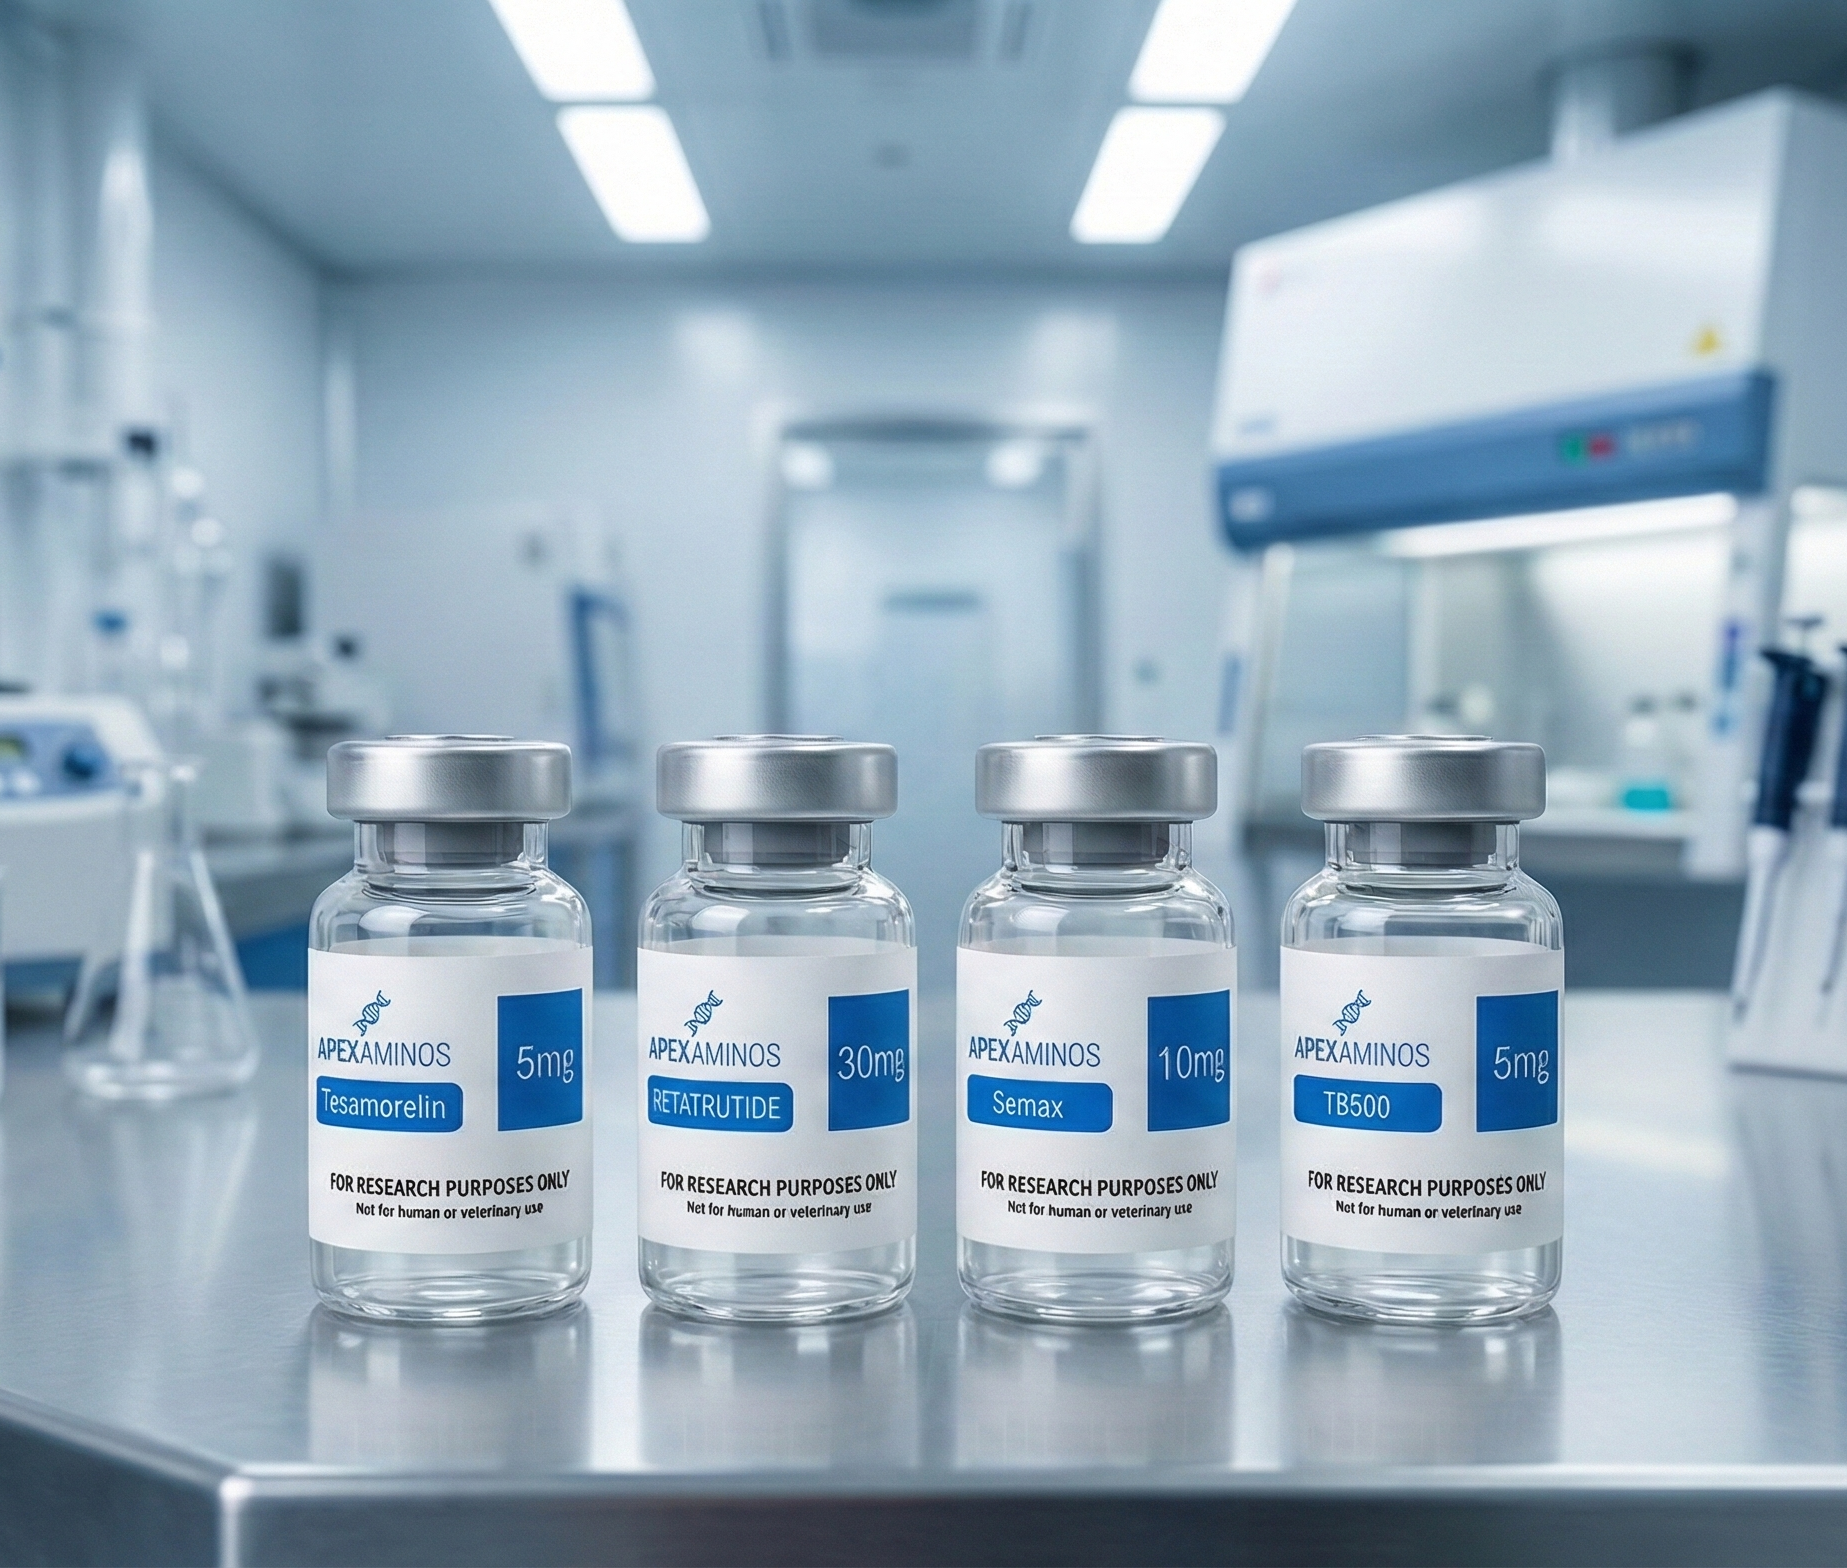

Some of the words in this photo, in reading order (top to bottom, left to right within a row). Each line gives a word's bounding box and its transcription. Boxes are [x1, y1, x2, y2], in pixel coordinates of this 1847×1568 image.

[318, 1037, 450, 1067] APEXAMINOS
[517, 1045, 574, 1083] 5mg
[649, 1036, 780, 1067] APEXAMINOS
[838, 1045, 905, 1082] 30mg
[968, 1036, 1100, 1067] APEXAMINOS
[1159, 1045, 1225, 1083] 10mg
[1295, 1036, 1429, 1067] APEXAMINOS
[1494, 1046, 1549, 1084] 5mg
[321, 1087, 445, 1119] Tesamorelin
[654, 1088, 780, 1119] RETATRUTIDE
[993, 1090, 1063, 1118] Semax
[1324, 1091, 1390, 1118] TB500
[330, 1172, 353, 1192] FOR
[357, 1177, 440, 1197] RESEARCH
[446, 1175, 533, 1197] PURPOSES
[538, 1170, 570, 1190] ONLY
[661, 1171, 683, 1191] FOR
[688, 1176, 770, 1196] RESEARCH
[776, 1175, 862, 1197] PURPOSES
[866, 1170, 897, 1190] ONLY
[981, 1171, 1004, 1191] FOR
[1008, 1176, 1091, 1196] RESEARCH
[1098, 1175, 1183, 1197] PURPOSES
[1187, 1170, 1218, 1190] ONLY
[1308, 1170, 1333, 1190] FOR
[1337, 1176, 1421, 1196] RESEARCH
[1427, 1175, 1512, 1197] PURPOSES
[1516, 1171, 1546, 1192] ONLY
[398, 1205, 440, 1218] human
[444, 1208, 457, 1218] or
[709, 1203, 724, 1216] for
[774, 1207, 786, 1218] or
[1029, 1202, 1045, 1216] for
[1049, 1205, 1091, 1218] human
[1095, 1207, 1107, 1218] or
[1112, 1205, 1171, 1219] veterinary
[1358, 1202, 1374, 1216] for
[1378, 1205, 1421, 1218] human
[1425, 1207, 1437, 1218] or
